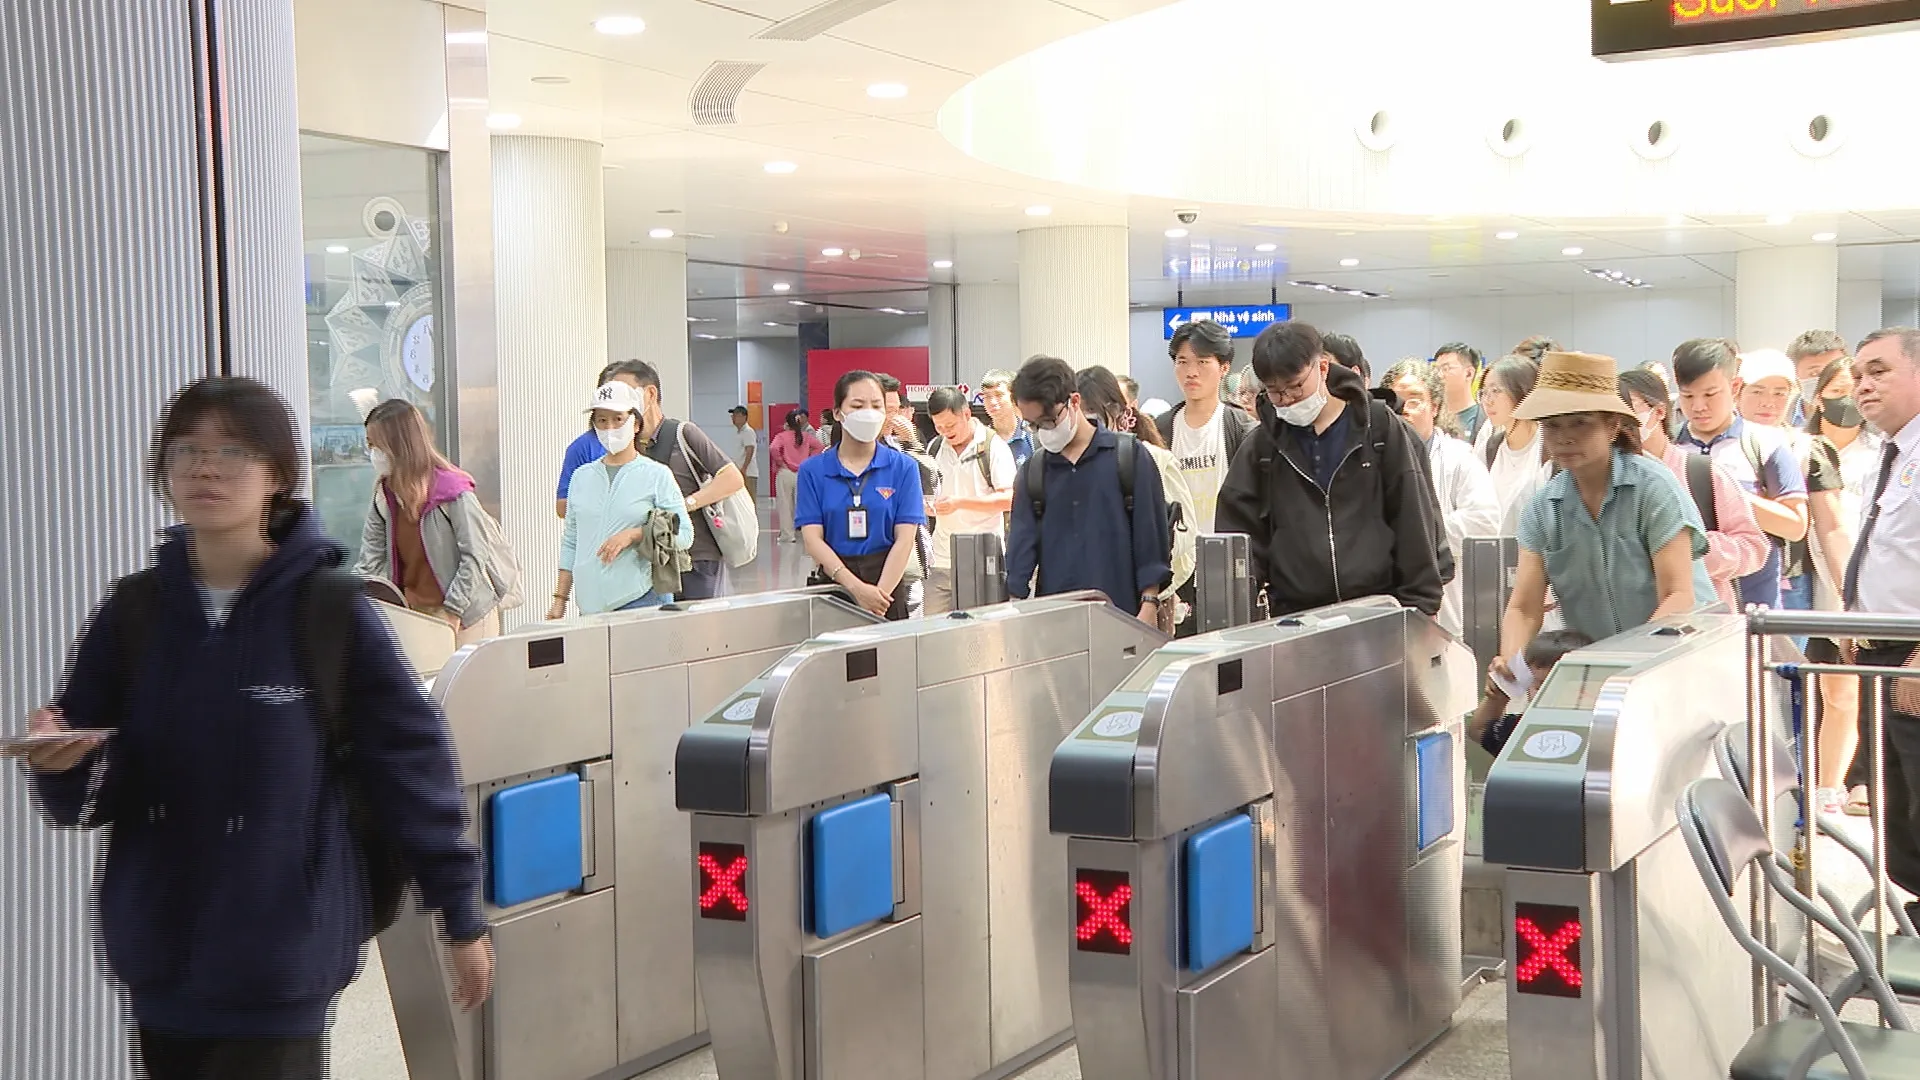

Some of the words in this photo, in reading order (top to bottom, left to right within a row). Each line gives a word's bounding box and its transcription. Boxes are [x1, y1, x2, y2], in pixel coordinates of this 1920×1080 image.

[1213, 311, 1235, 323] Nhà
[1252, 309, 1275, 322] sinh
[1180, 454, 1216, 471] SMILEY
